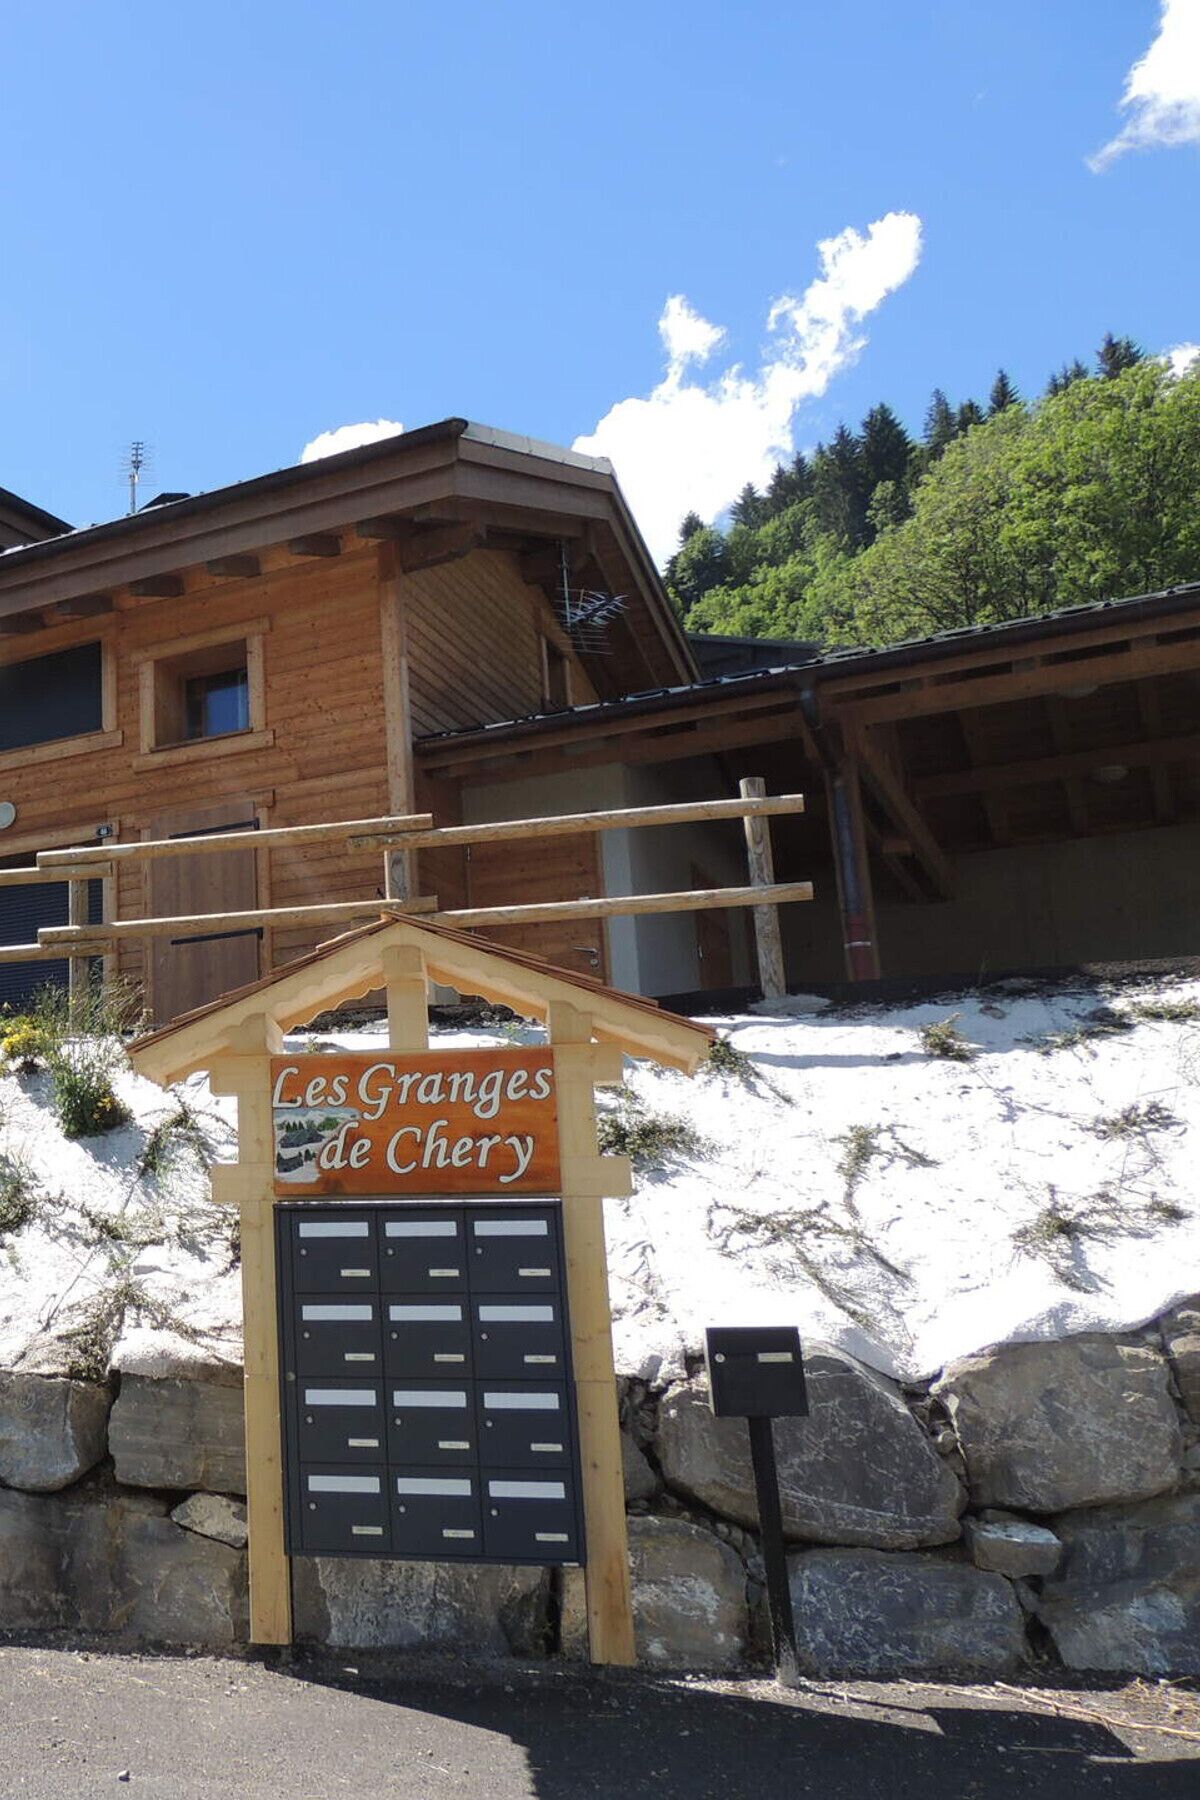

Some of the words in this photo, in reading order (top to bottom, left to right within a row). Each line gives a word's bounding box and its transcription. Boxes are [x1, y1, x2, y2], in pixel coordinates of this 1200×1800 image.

[273, 1066, 349, 1108] Les
[358, 1063, 553, 1120] Granges
[319, 1121, 372, 1170] de
[386, 1119, 534, 1184] Chery
